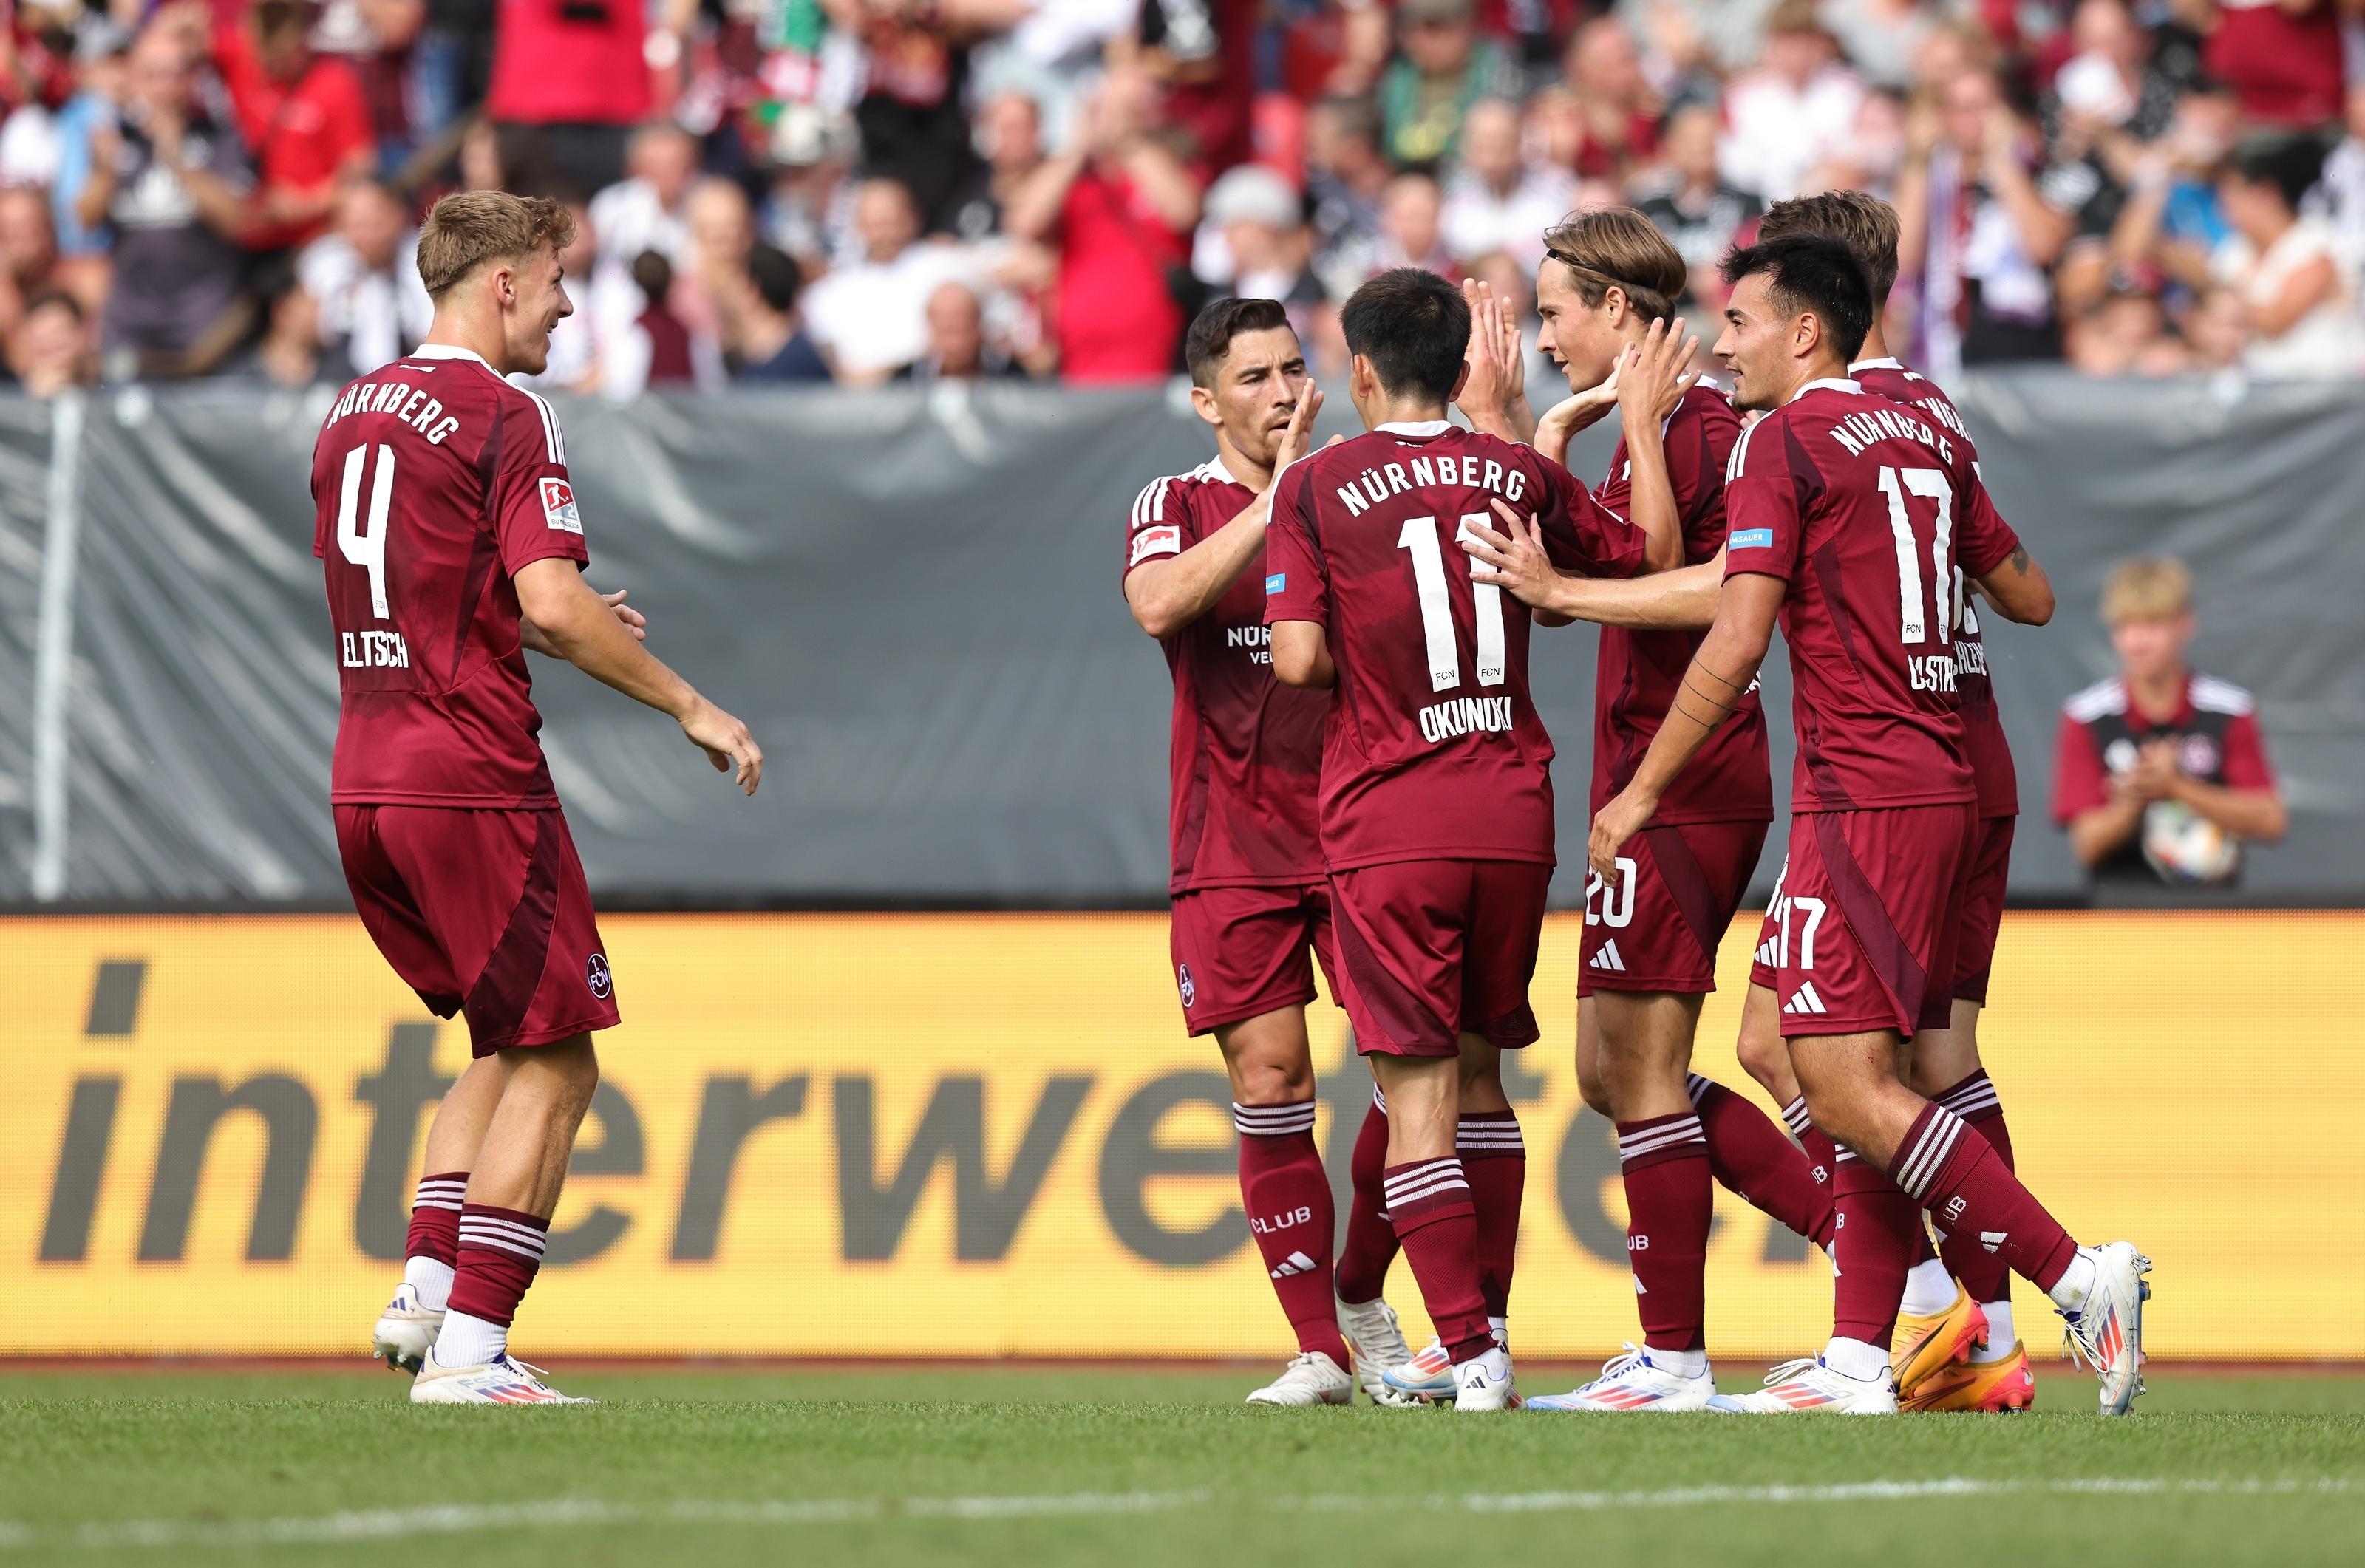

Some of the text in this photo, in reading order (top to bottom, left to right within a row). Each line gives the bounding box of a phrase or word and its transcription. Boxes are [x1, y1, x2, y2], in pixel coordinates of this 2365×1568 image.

[327, 383, 460, 445] NÜRNBERG
[1336, 456, 1526, 517] NÜRNBERG
[337, 443, 395, 619] 4
[1729, 534, 1763, 544] MSAUER
[1877, 466, 1952, 644] 17
[1397, 512, 1505, 692] 11
[1228, 626, 1272, 647] NÜR
[1906, 624, 1922, 633] FCN
[1435, 670, 1455, 682] FCN
[1481, 668, 1500, 678] FCN
[1585, 857, 1638, 928] 20
[1780, 896, 1828, 970] 17
[590, 969, 610, 991] FCN
[1250, 1205, 1312, 1234] CLUB
[1627, 1235, 1650, 1250] UB
